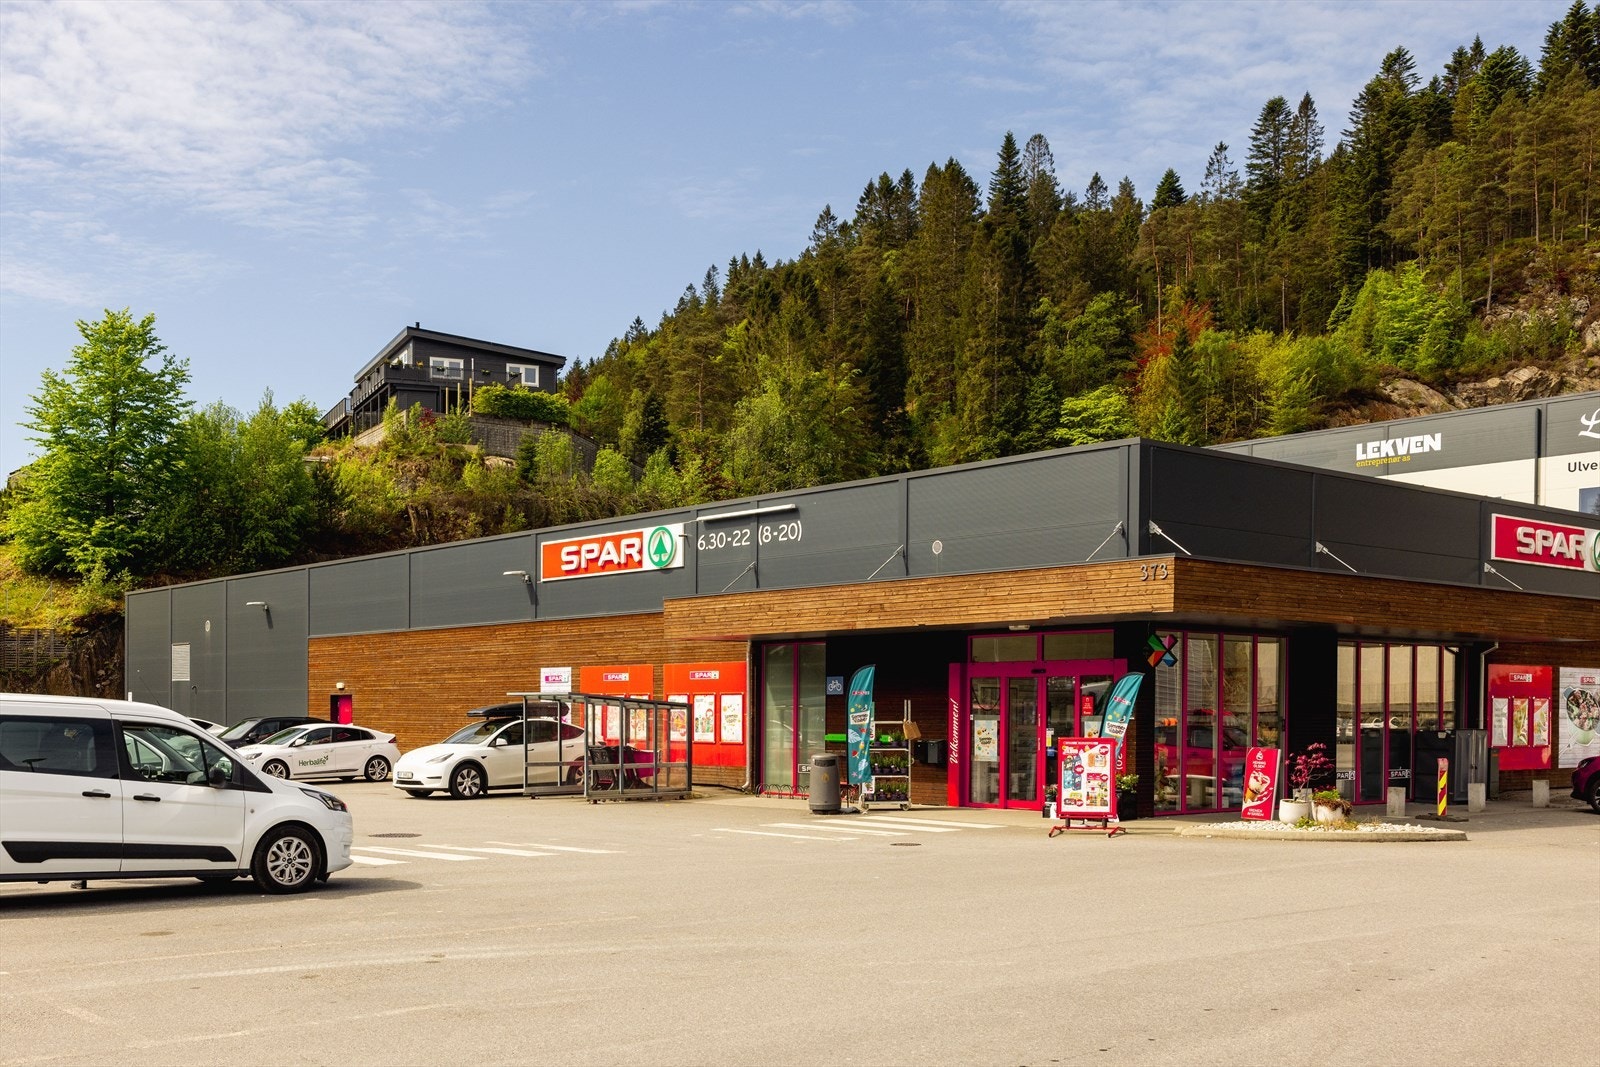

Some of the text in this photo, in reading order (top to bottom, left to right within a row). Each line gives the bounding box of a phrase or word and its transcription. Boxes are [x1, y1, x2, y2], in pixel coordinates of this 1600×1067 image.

[1356, 433, 1442, 461] LEKVEN
[1356, 456, 1401, 467] entreprenør
[1568, 461, 1600, 473] Ulve
[697, 520, 802, 550] 6.30-22 (8-20)
[1516, 526, 1585, 560] SPAR
[561, 537, 642, 571] SPAR
[1140, 563, 1168, 581] 373
[548, 674, 563, 682] SPAR
[950, 698, 959, 764] Velkommen!
[299, 757, 327, 767] Herbalife
